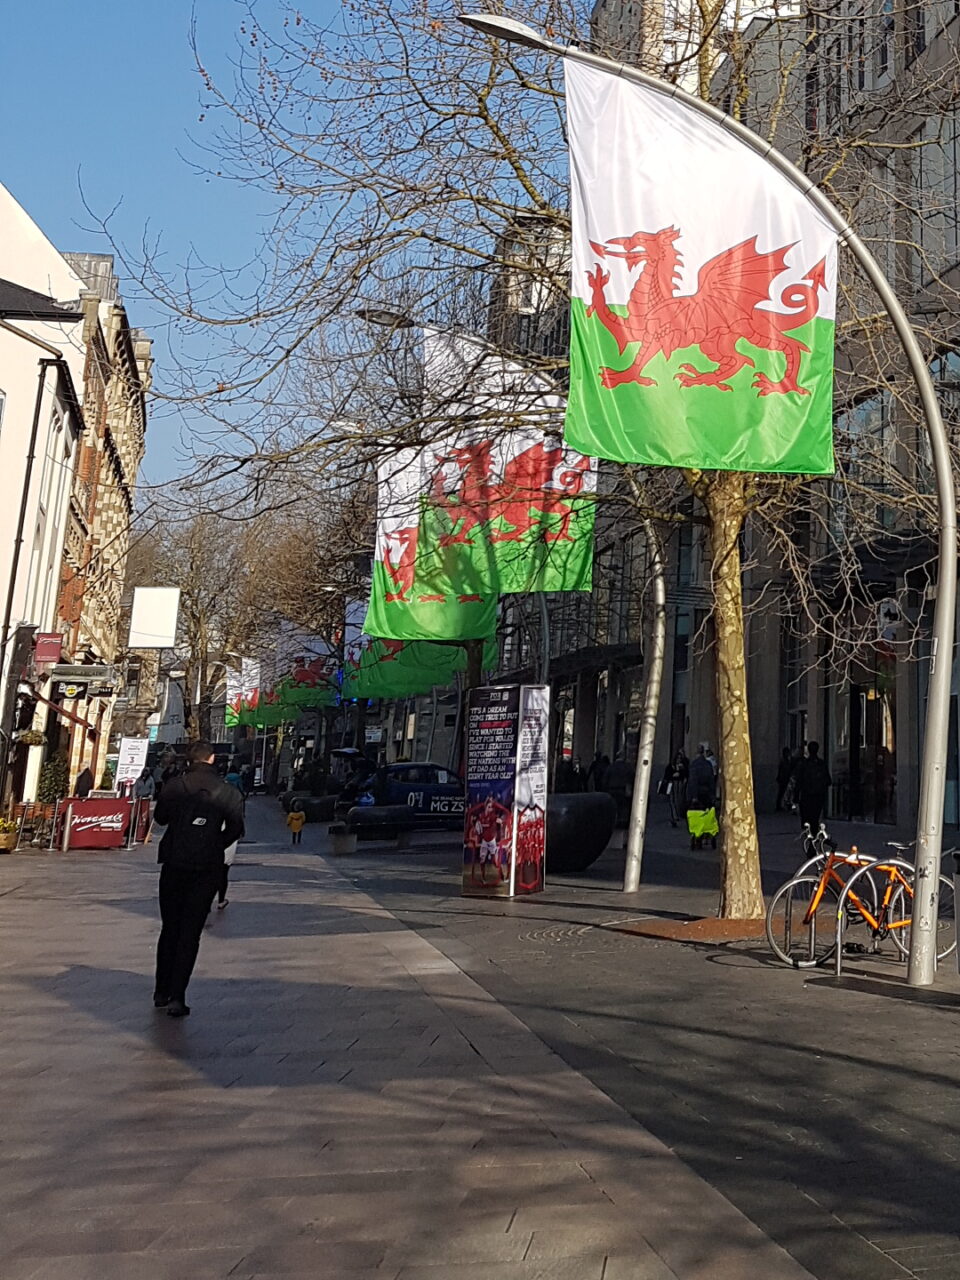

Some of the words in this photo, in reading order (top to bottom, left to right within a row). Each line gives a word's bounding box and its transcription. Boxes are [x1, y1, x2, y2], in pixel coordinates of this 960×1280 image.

[488, 742, 514, 750] STARTED
[468, 750, 498, 758] WATCHING
[430, 801, 449, 812] MG
[451, 801, 465, 812] ZS
